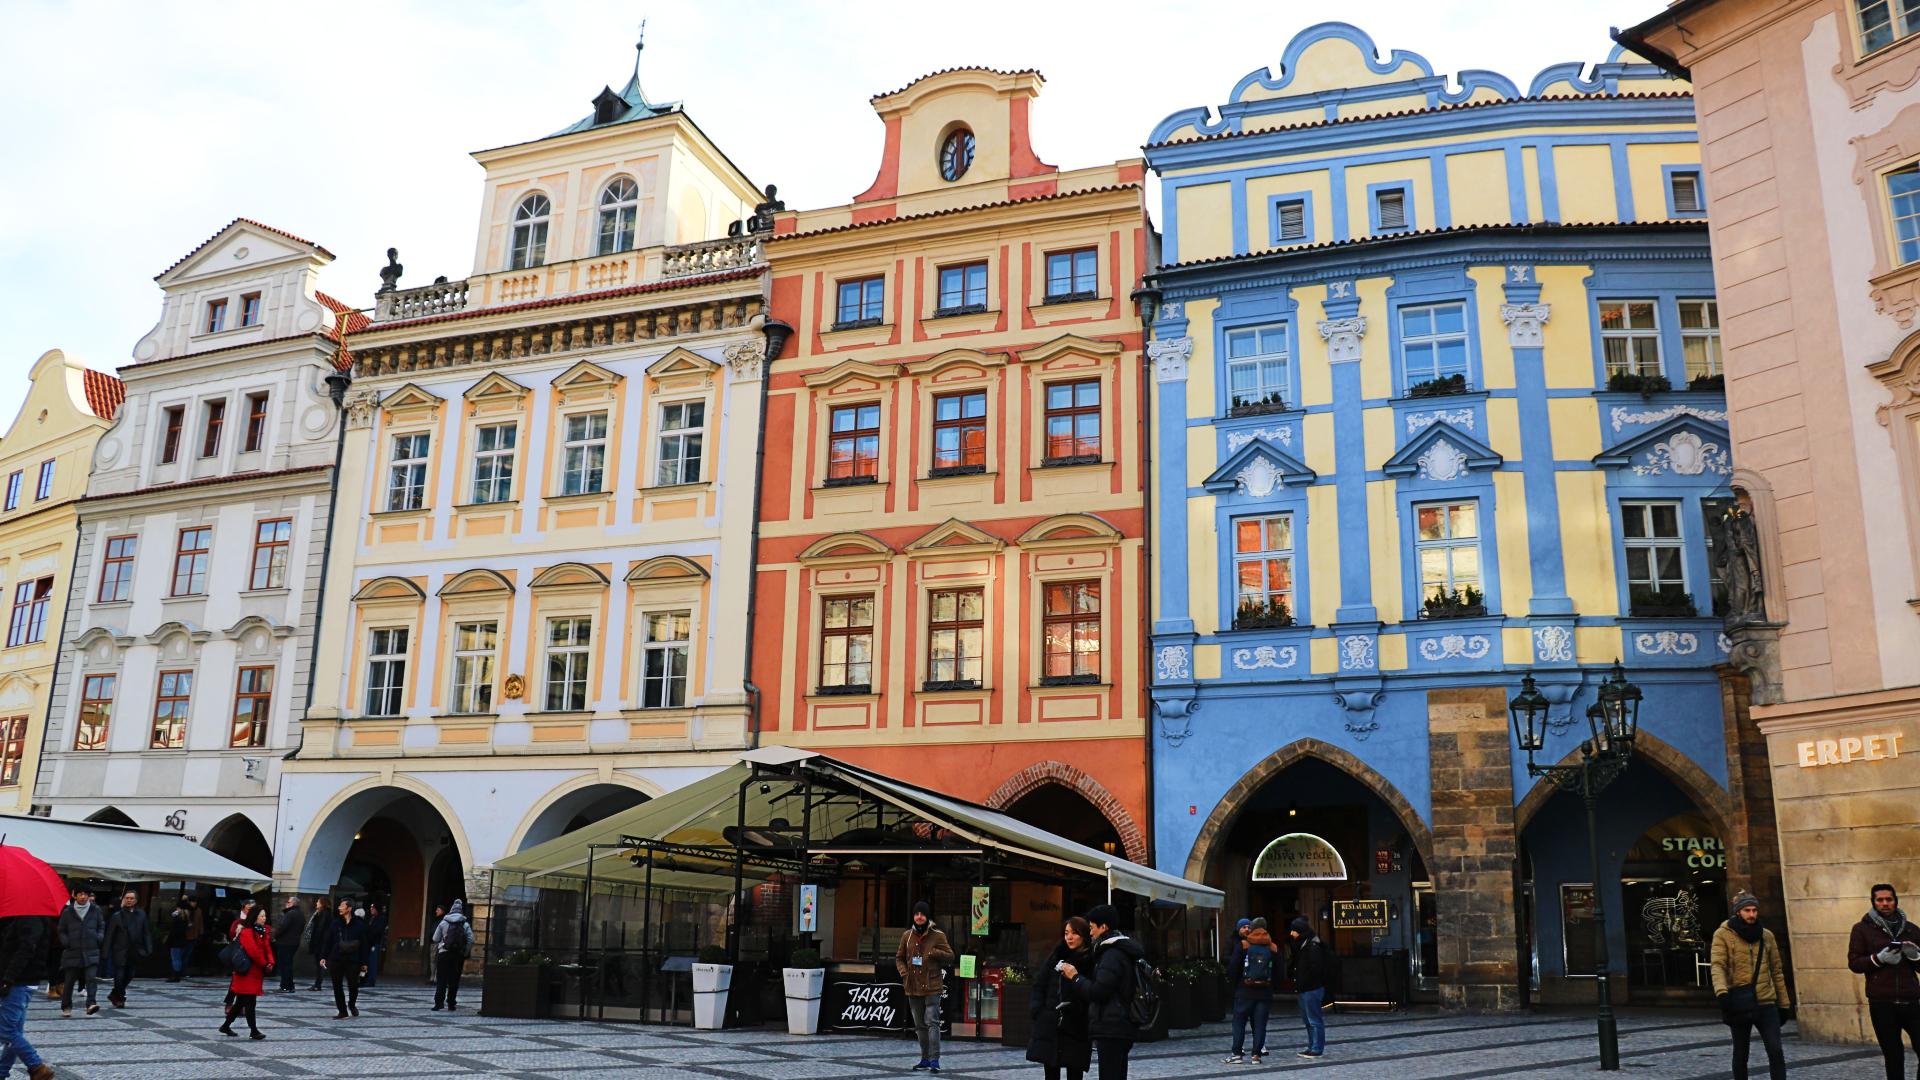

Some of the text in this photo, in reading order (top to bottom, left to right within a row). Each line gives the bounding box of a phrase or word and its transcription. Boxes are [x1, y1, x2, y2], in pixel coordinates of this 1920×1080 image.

[1797, 732, 1903, 768] ERPET
[848, 987, 890, 1003] TAKE
[841, 1005, 896, 1027] AWAY
